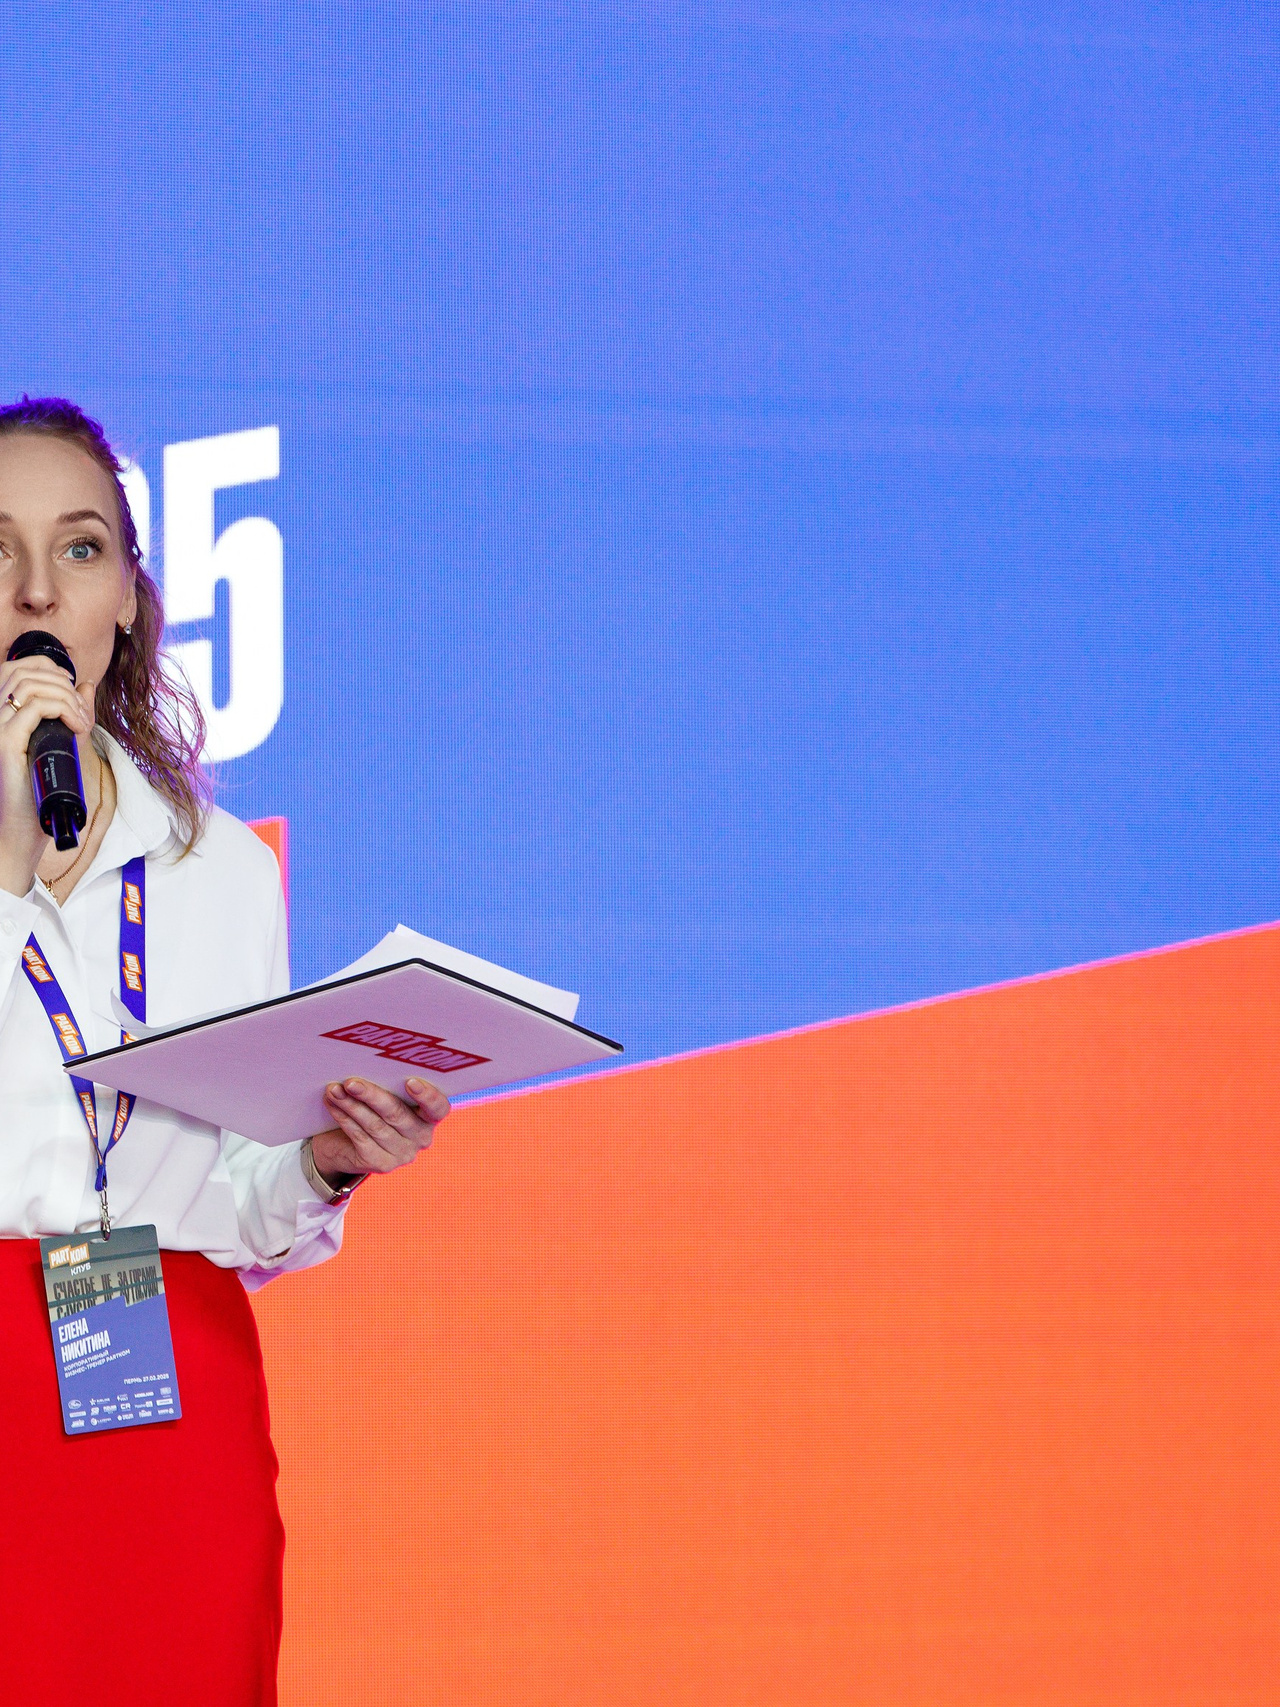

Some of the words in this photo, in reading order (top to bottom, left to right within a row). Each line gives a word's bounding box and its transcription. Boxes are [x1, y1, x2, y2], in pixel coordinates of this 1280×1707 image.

[70, 1262, 92, 1276] КЛУБ
[53, 1276, 96, 1300] СЧАСТЬЕ
[101, 1273, 112, 1291] НЕ
[58, 1317, 89, 1343] ЕЛЕНА
[61, 1330, 111, 1363] НИКИТИНА
